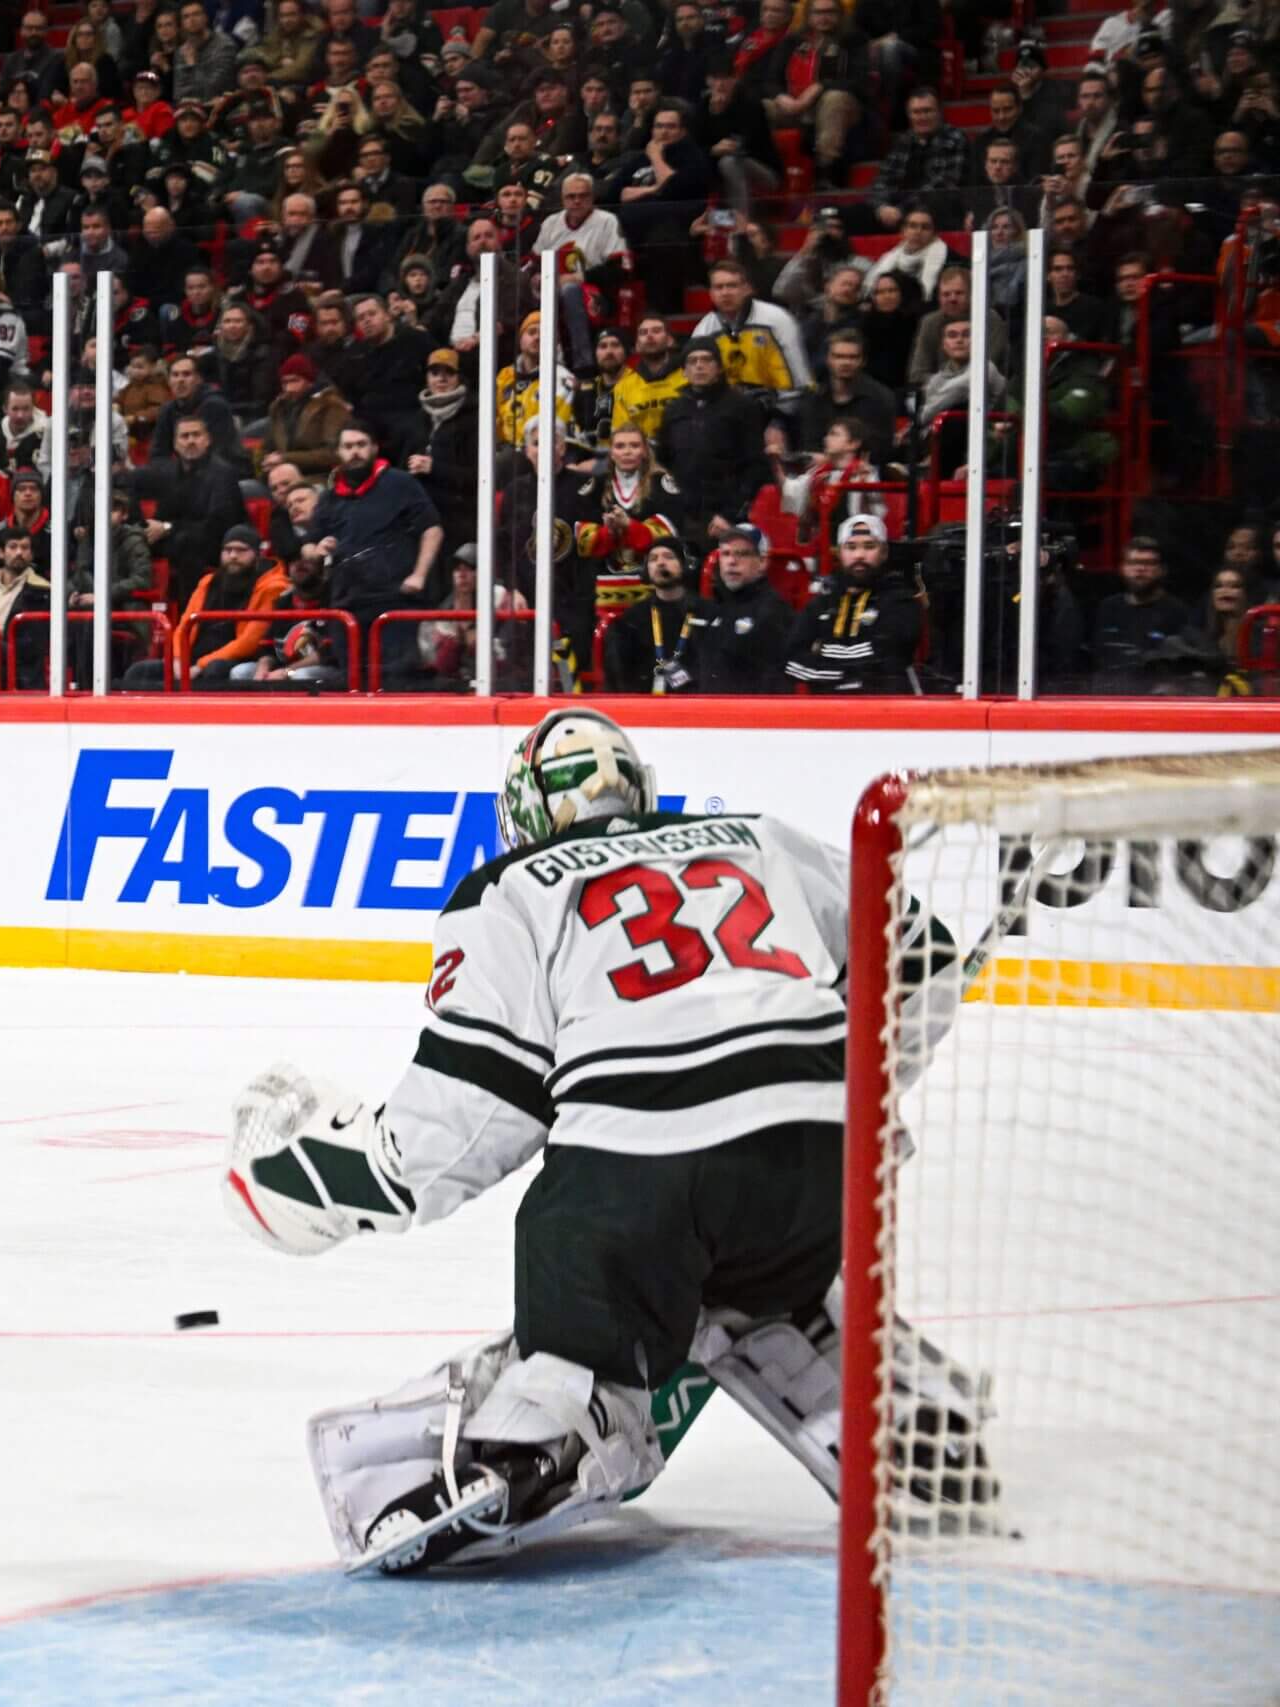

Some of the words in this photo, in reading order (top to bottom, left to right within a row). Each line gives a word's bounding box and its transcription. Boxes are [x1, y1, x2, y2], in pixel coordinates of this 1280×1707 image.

[525, 821, 761, 887] GUSTAVSSON
[577, 858, 812, 1002] 32
[424, 946, 465, 1008] 2
